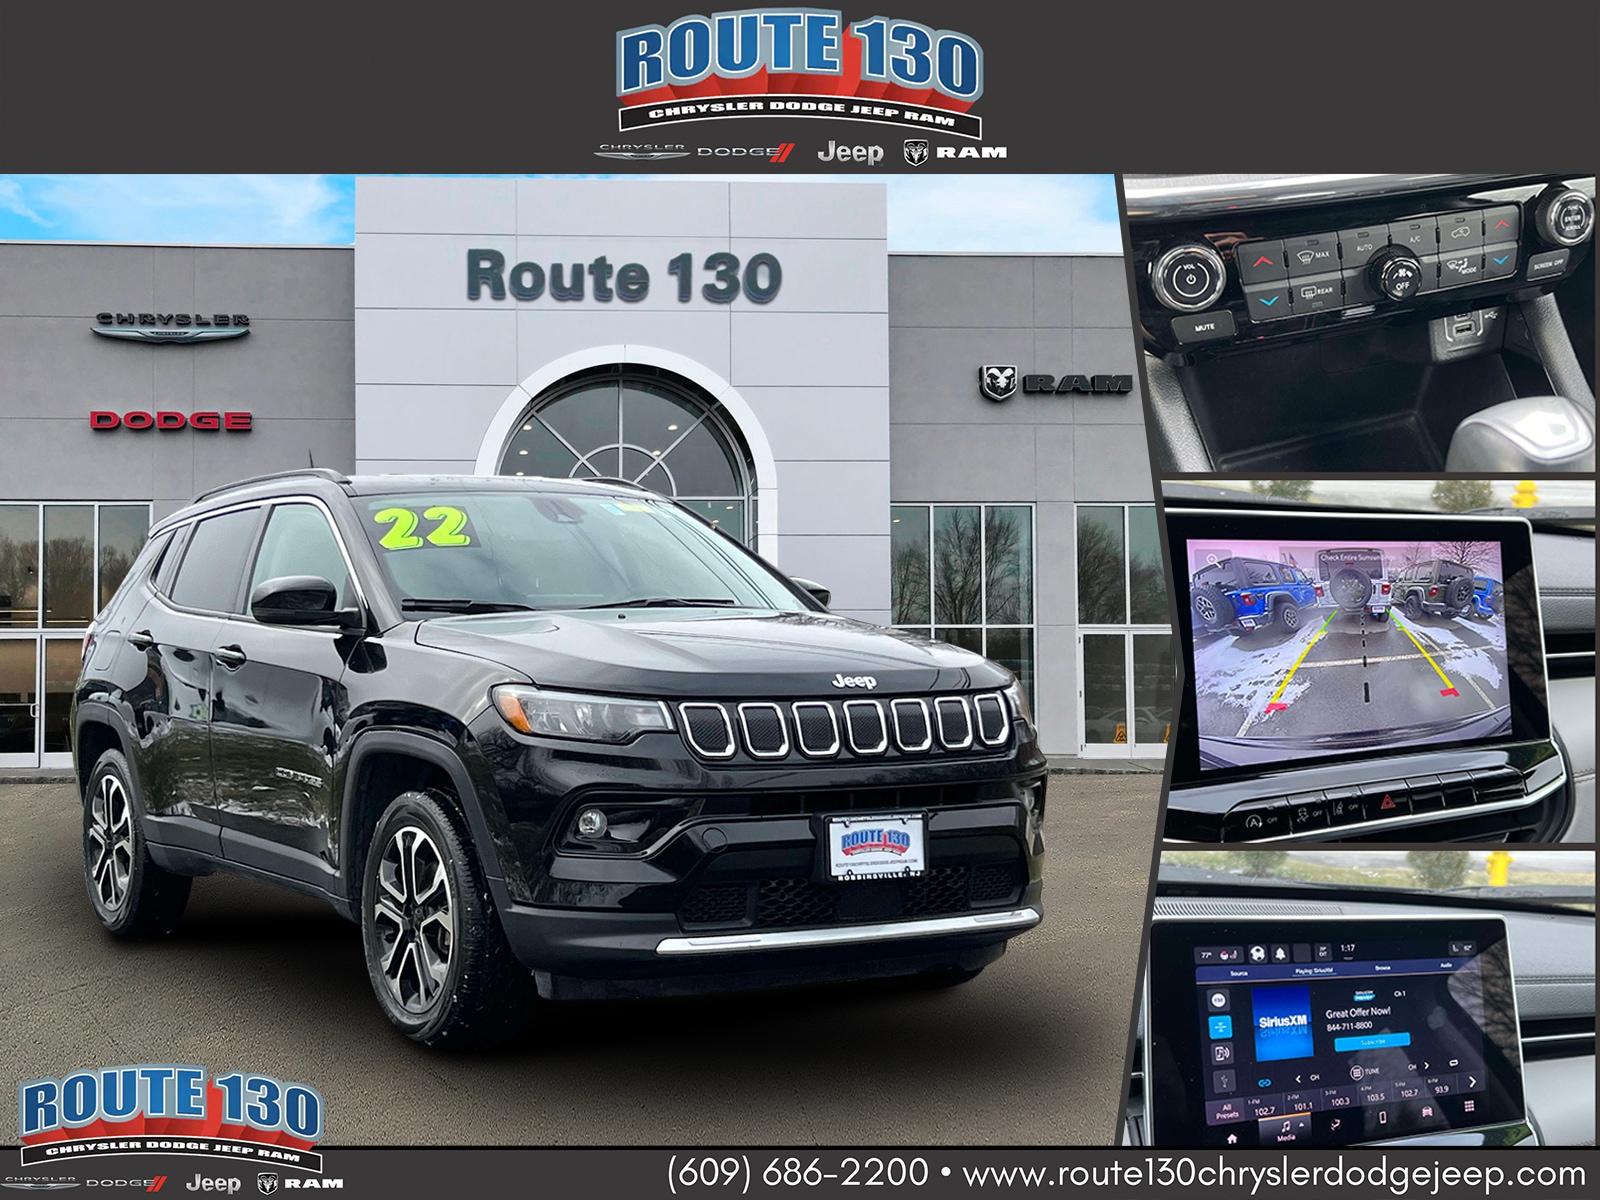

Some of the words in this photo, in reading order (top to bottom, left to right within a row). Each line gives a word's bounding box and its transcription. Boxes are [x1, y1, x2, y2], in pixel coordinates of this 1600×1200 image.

[1409, 235, 1421, 244] A/C
[1356, 243, 1374, 251] AUTO
[1315, 250, 1331, 259] MAX
[1534, 262, 1553, 271] SCREEN
[1554, 258, 1564, 267] OFF
[1461, 265, 1478, 275] MODE
[467, 248, 650, 302] Route
[667, 251, 783, 305] 130
[1395, 281, 1410, 290] OFF
[1317, 286, 1334, 296] REAR
[96, 312, 251, 326] CHRYSLER
[1194, 323, 1216, 332] MUTE
[1022, 374, 1134, 395] RAM
[90, 410, 253, 431] DODGE
[374, 506, 471, 551] 22
[832, 674, 877, 691] Jeep
[841, 828, 885, 849] ROUTE
[887, 829, 911, 848] 130
[1340, 944, 1356, 952] 1:17
[1325, 1008, 1349, 1019] Great
[1349, 1007, 1370, 1018] Offer
[1371, 1006, 1391, 1016] Now!
[1259, 1014, 1307, 1029] SiriusXM
[1326, 1020, 1373, 1032] 844-711-8800
[1401, 1089, 1419, 1098] 102.7
[1435, 1085, 1450, 1094] 93.9
[1331, 1097, 1350, 1107] 100.3
[1367, 1093, 1386, 1102] 103.5
[1222, 1103, 1232, 1111] All
[1255, 1106, 1276, 1116] 102.7
[1294, 1102, 1313, 1111] 101.1
[1216, 1111, 1240, 1120] Presets
[1277, 1134, 1296, 1142] Media
